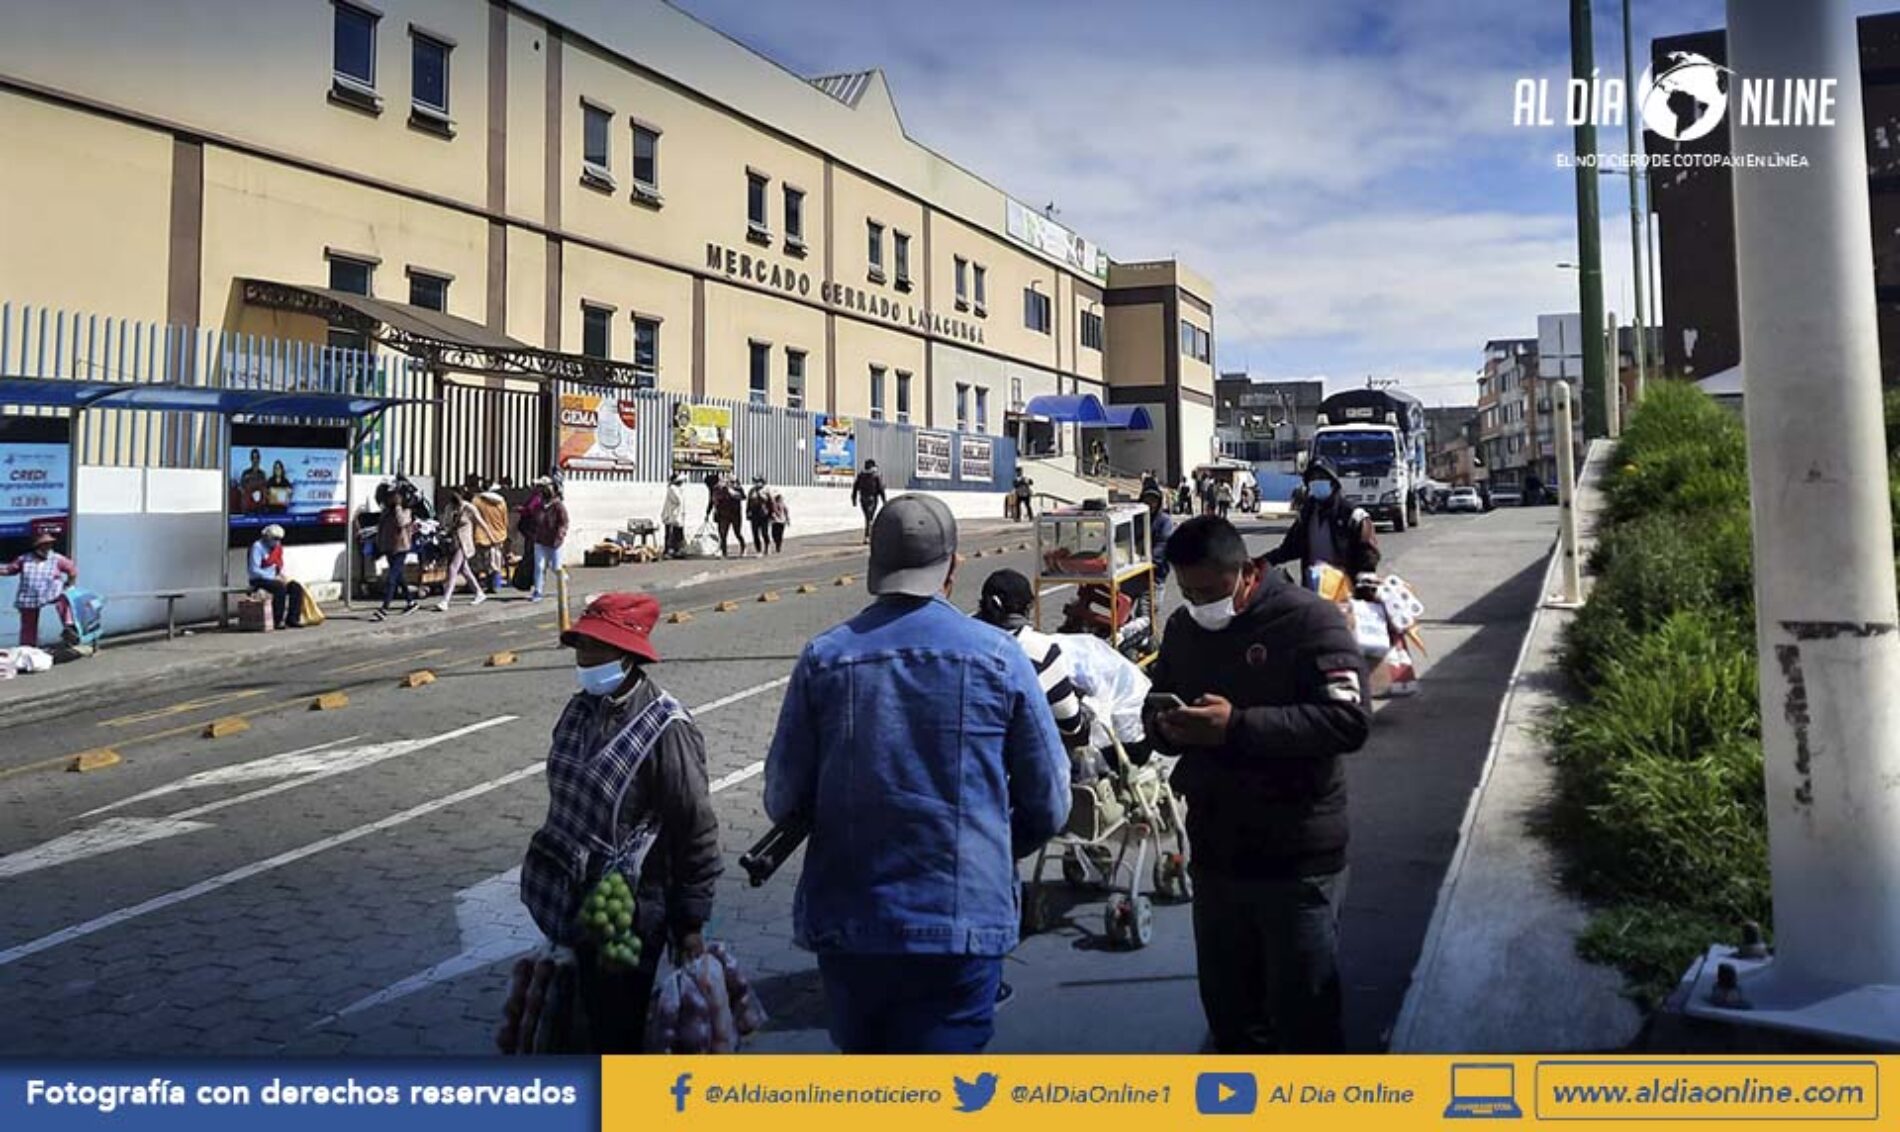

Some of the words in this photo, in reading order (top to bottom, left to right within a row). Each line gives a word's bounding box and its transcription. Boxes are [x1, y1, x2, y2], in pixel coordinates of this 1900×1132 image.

[706, 242, 811, 296] MERCADO
[821, 280, 901, 321] CERRADO
[907, 306, 985, 345] LATACUNGA
[561, 409, 597, 426] GEMA
